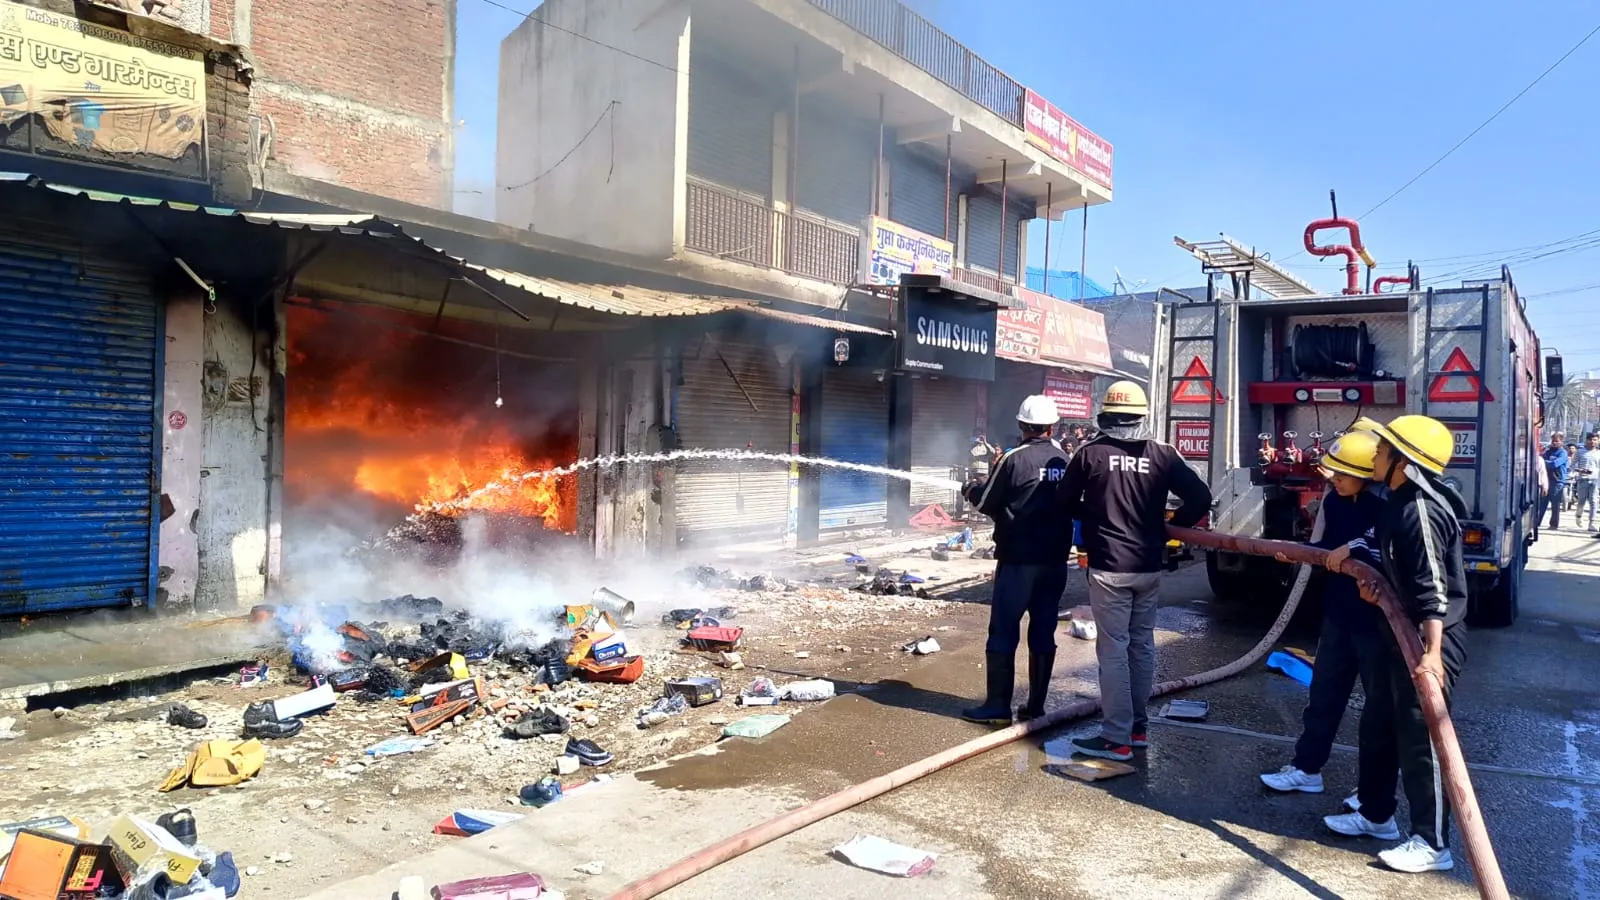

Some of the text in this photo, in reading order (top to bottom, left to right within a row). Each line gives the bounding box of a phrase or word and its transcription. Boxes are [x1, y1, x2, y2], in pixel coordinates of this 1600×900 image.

[28, 38, 82, 73] एण्ड
[917, 316, 988, 355] SAMSUNG
[1107, 392, 1132, 402] FIRE
[1178, 440, 1209, 452] POLICE
[1455, 433, 1468, 444] 07
[1109, 455, 1150, 474] FIRE
